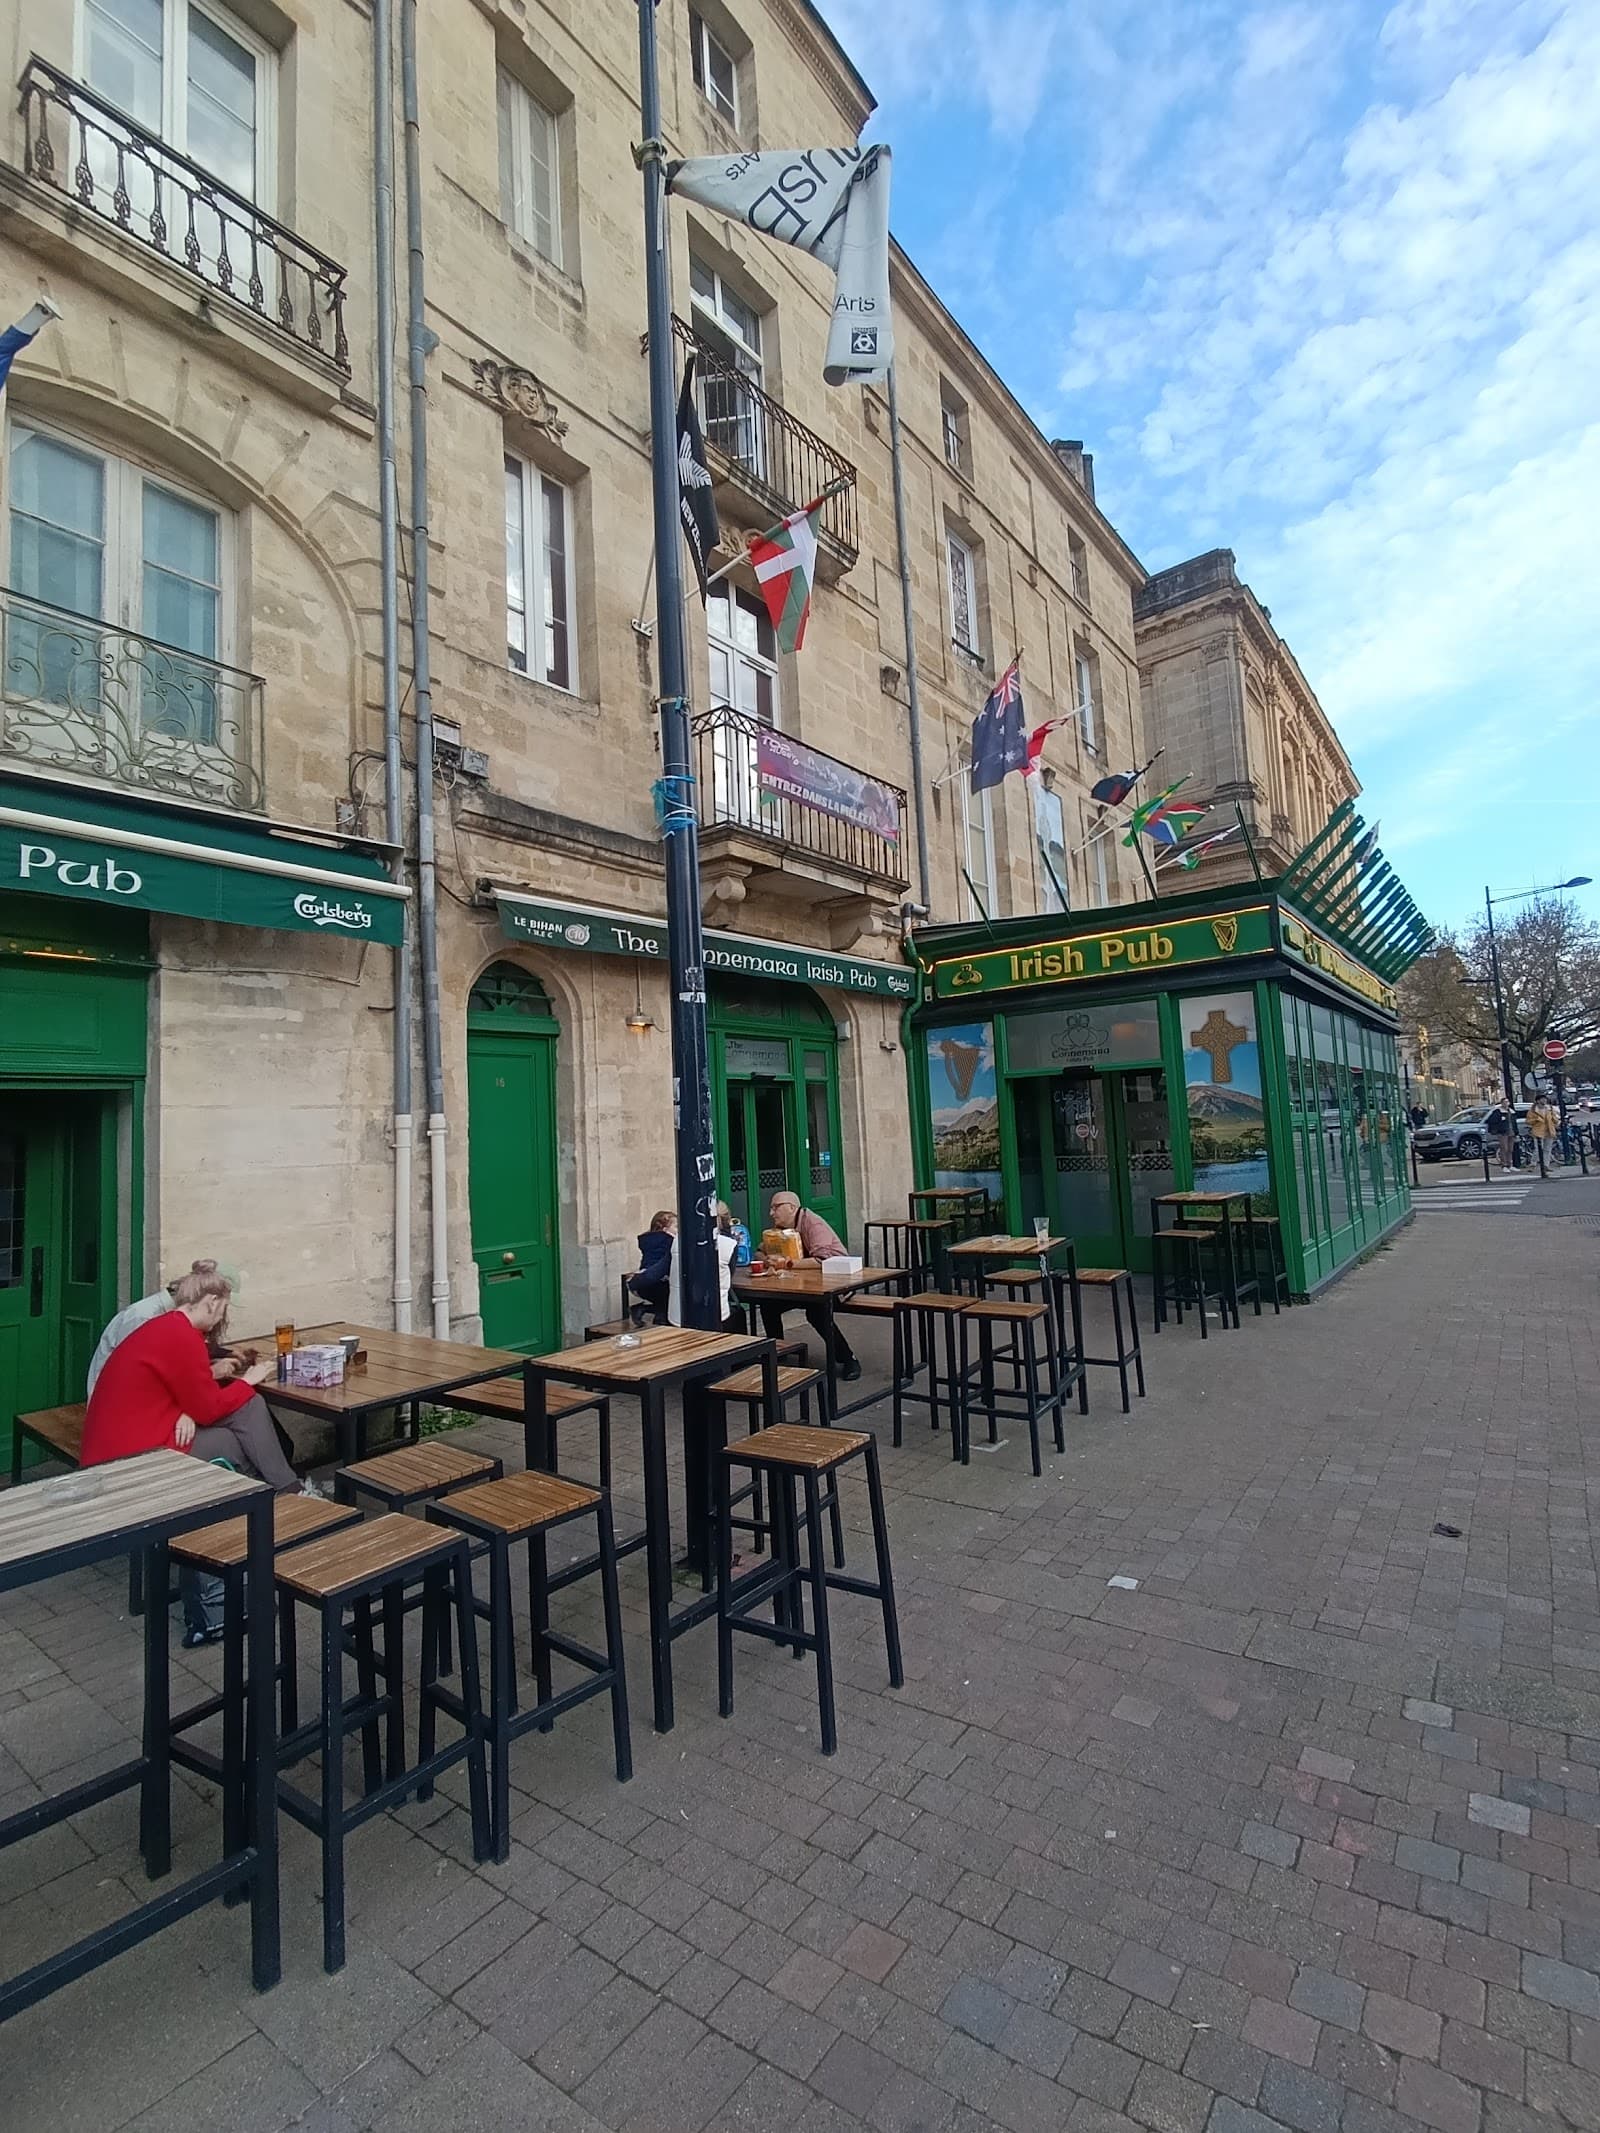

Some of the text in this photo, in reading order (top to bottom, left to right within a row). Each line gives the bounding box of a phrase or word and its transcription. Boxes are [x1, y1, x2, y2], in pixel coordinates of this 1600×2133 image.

[834, 293, 875, 312] Arts
[762, 772, 802, 798] ENTREZ
[802, 787, 828, 807] DANS
[828, 799, 840, 813] LA
[19, 843, 142, 895] Pub
[294, 893, 372, 928] Carlsberg
[514, 916, 563, 933] LE BIHAN
[611, 927, 877, 988] The nnemara Irish Pub
[1010, 932, 1174, 981] Irish Pub
